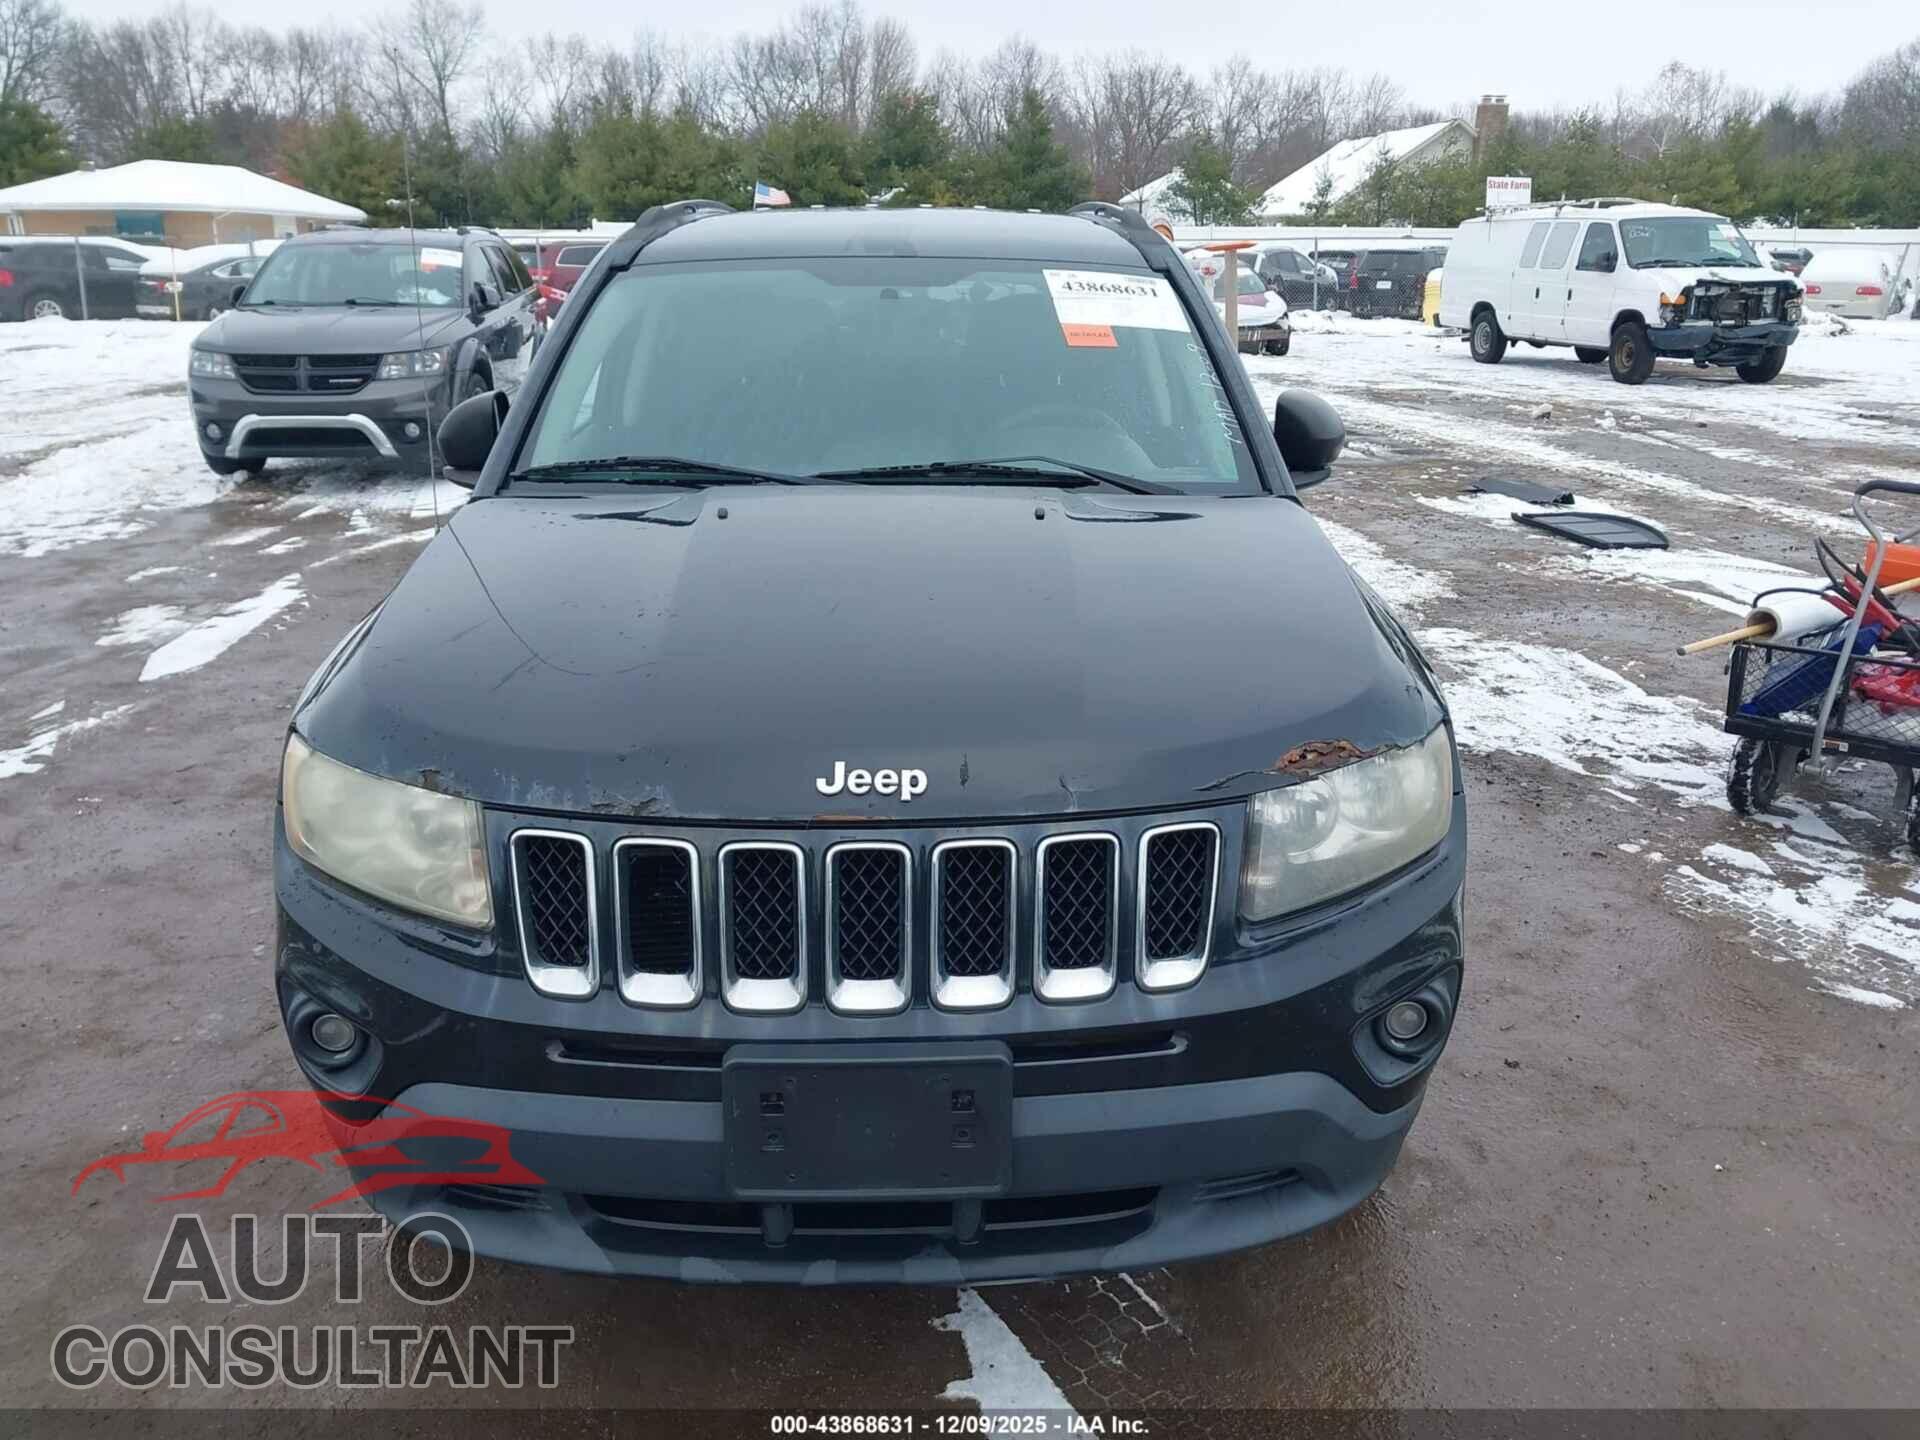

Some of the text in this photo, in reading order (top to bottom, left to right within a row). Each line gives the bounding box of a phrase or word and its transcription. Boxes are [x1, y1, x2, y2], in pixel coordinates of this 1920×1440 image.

[1488, 180, 1530, 189] State Farm
[1062, 281, 1159, 297] 43868631
[816, 761, 928, 801] Jeep
